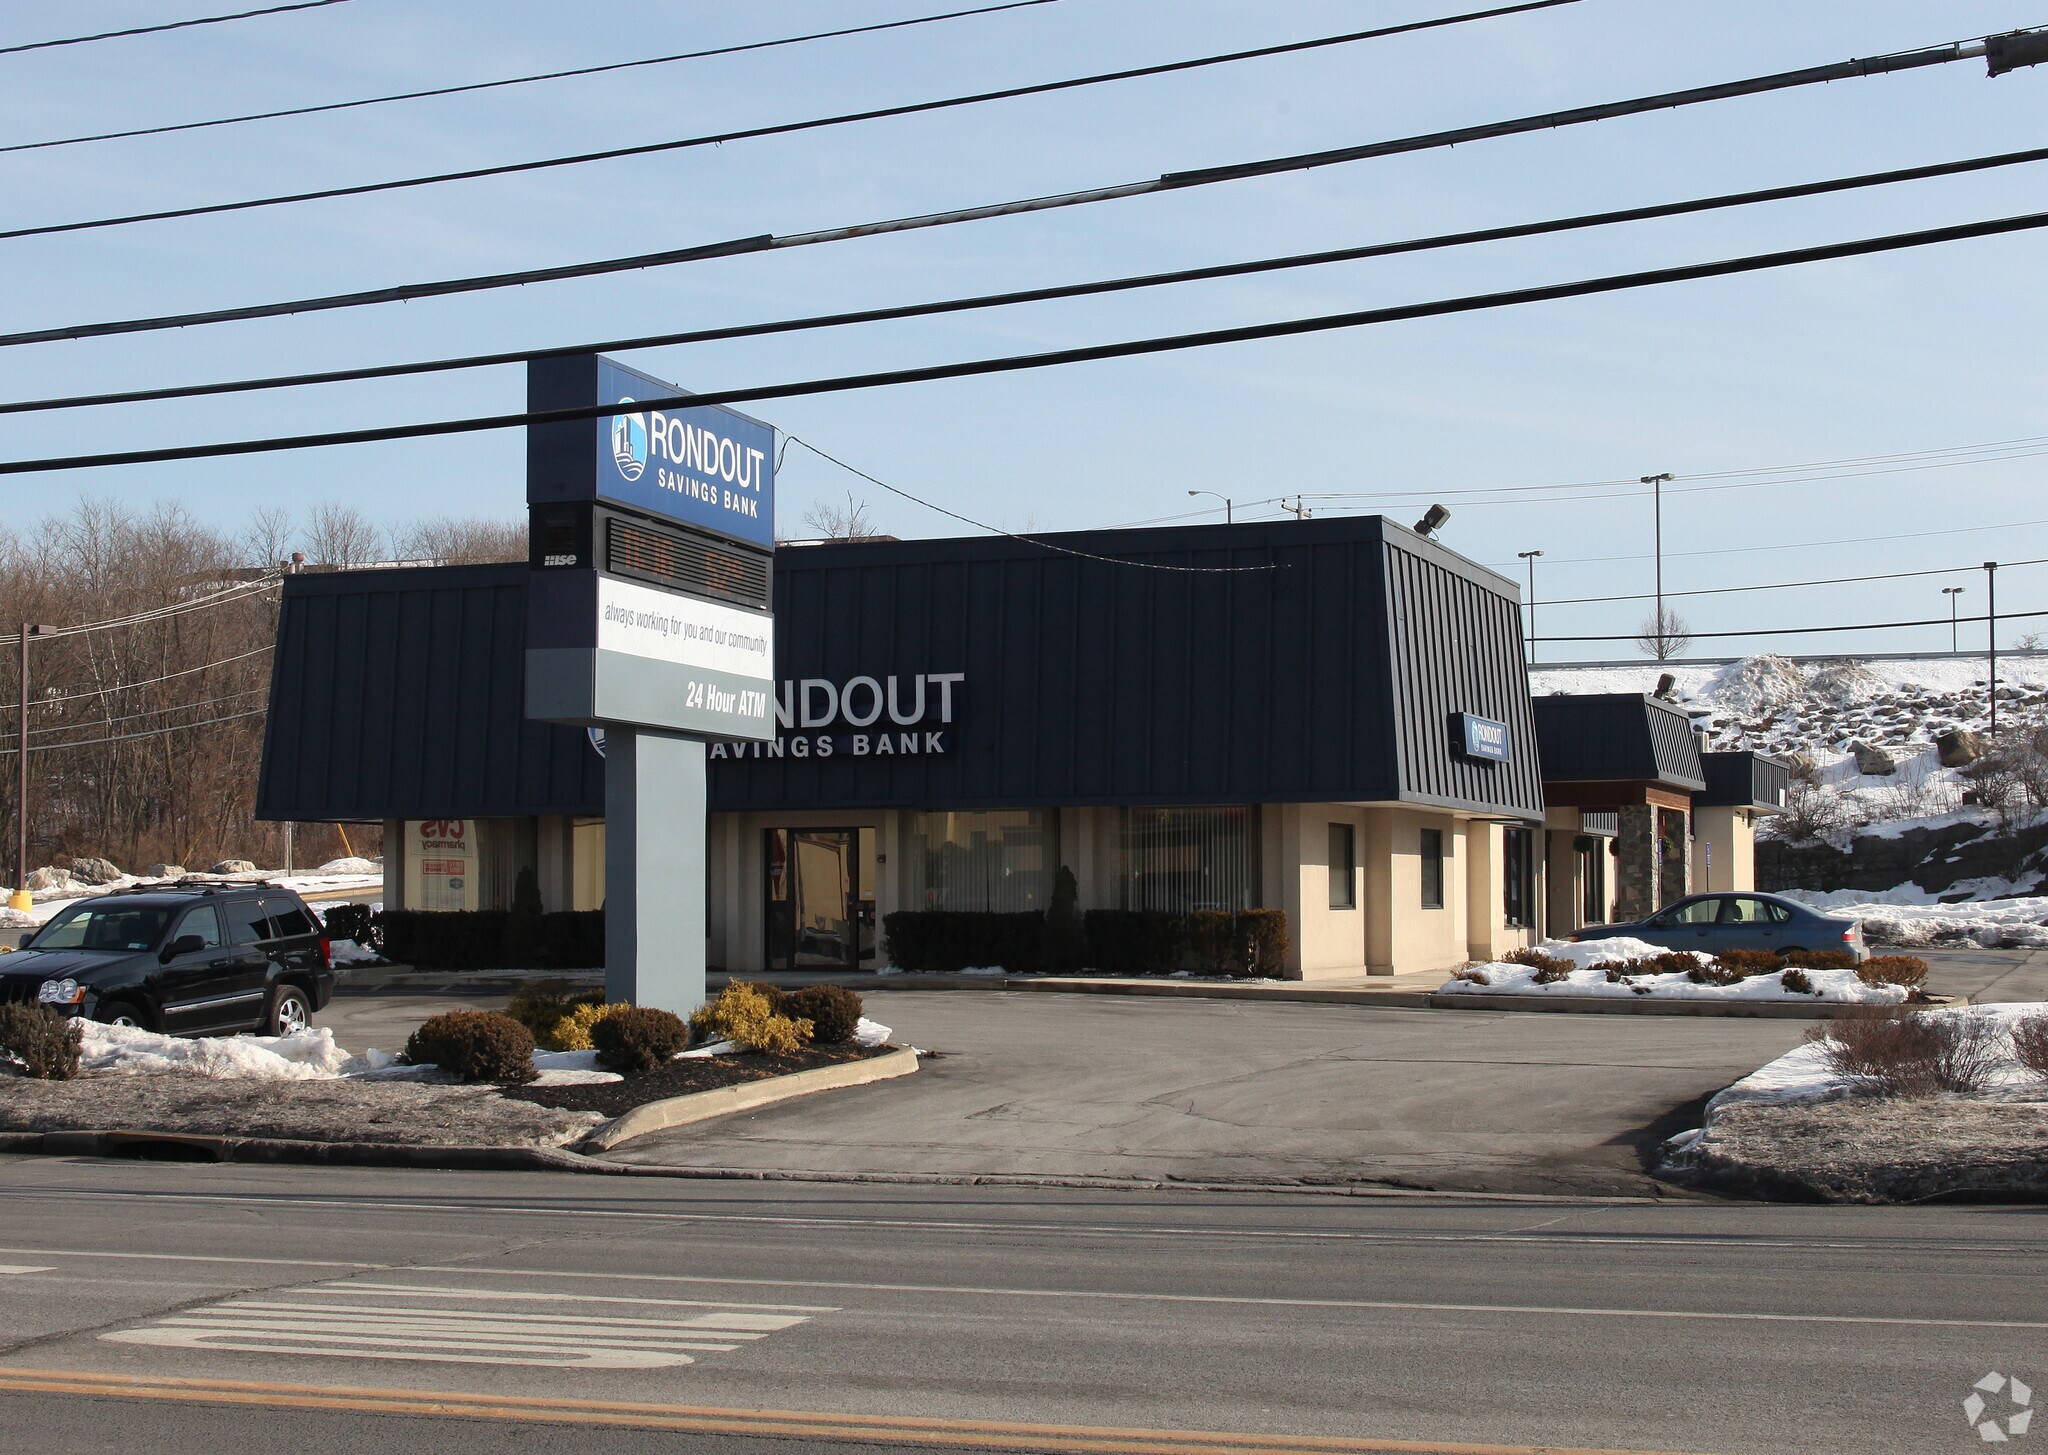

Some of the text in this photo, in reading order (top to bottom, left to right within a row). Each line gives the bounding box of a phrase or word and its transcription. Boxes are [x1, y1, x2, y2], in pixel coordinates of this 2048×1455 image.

[651, 410, 766, 492] RONDOUT
[658, 467, 758, 518] SAVINGS BANK
[604, 601, 767, 657] always working for you and our community
[685, 681, 766, 718] 24 Hour ATM
[774, 672, 965, 729] NDOUT
[709, 731, 945, 759] AVINGS BANK
